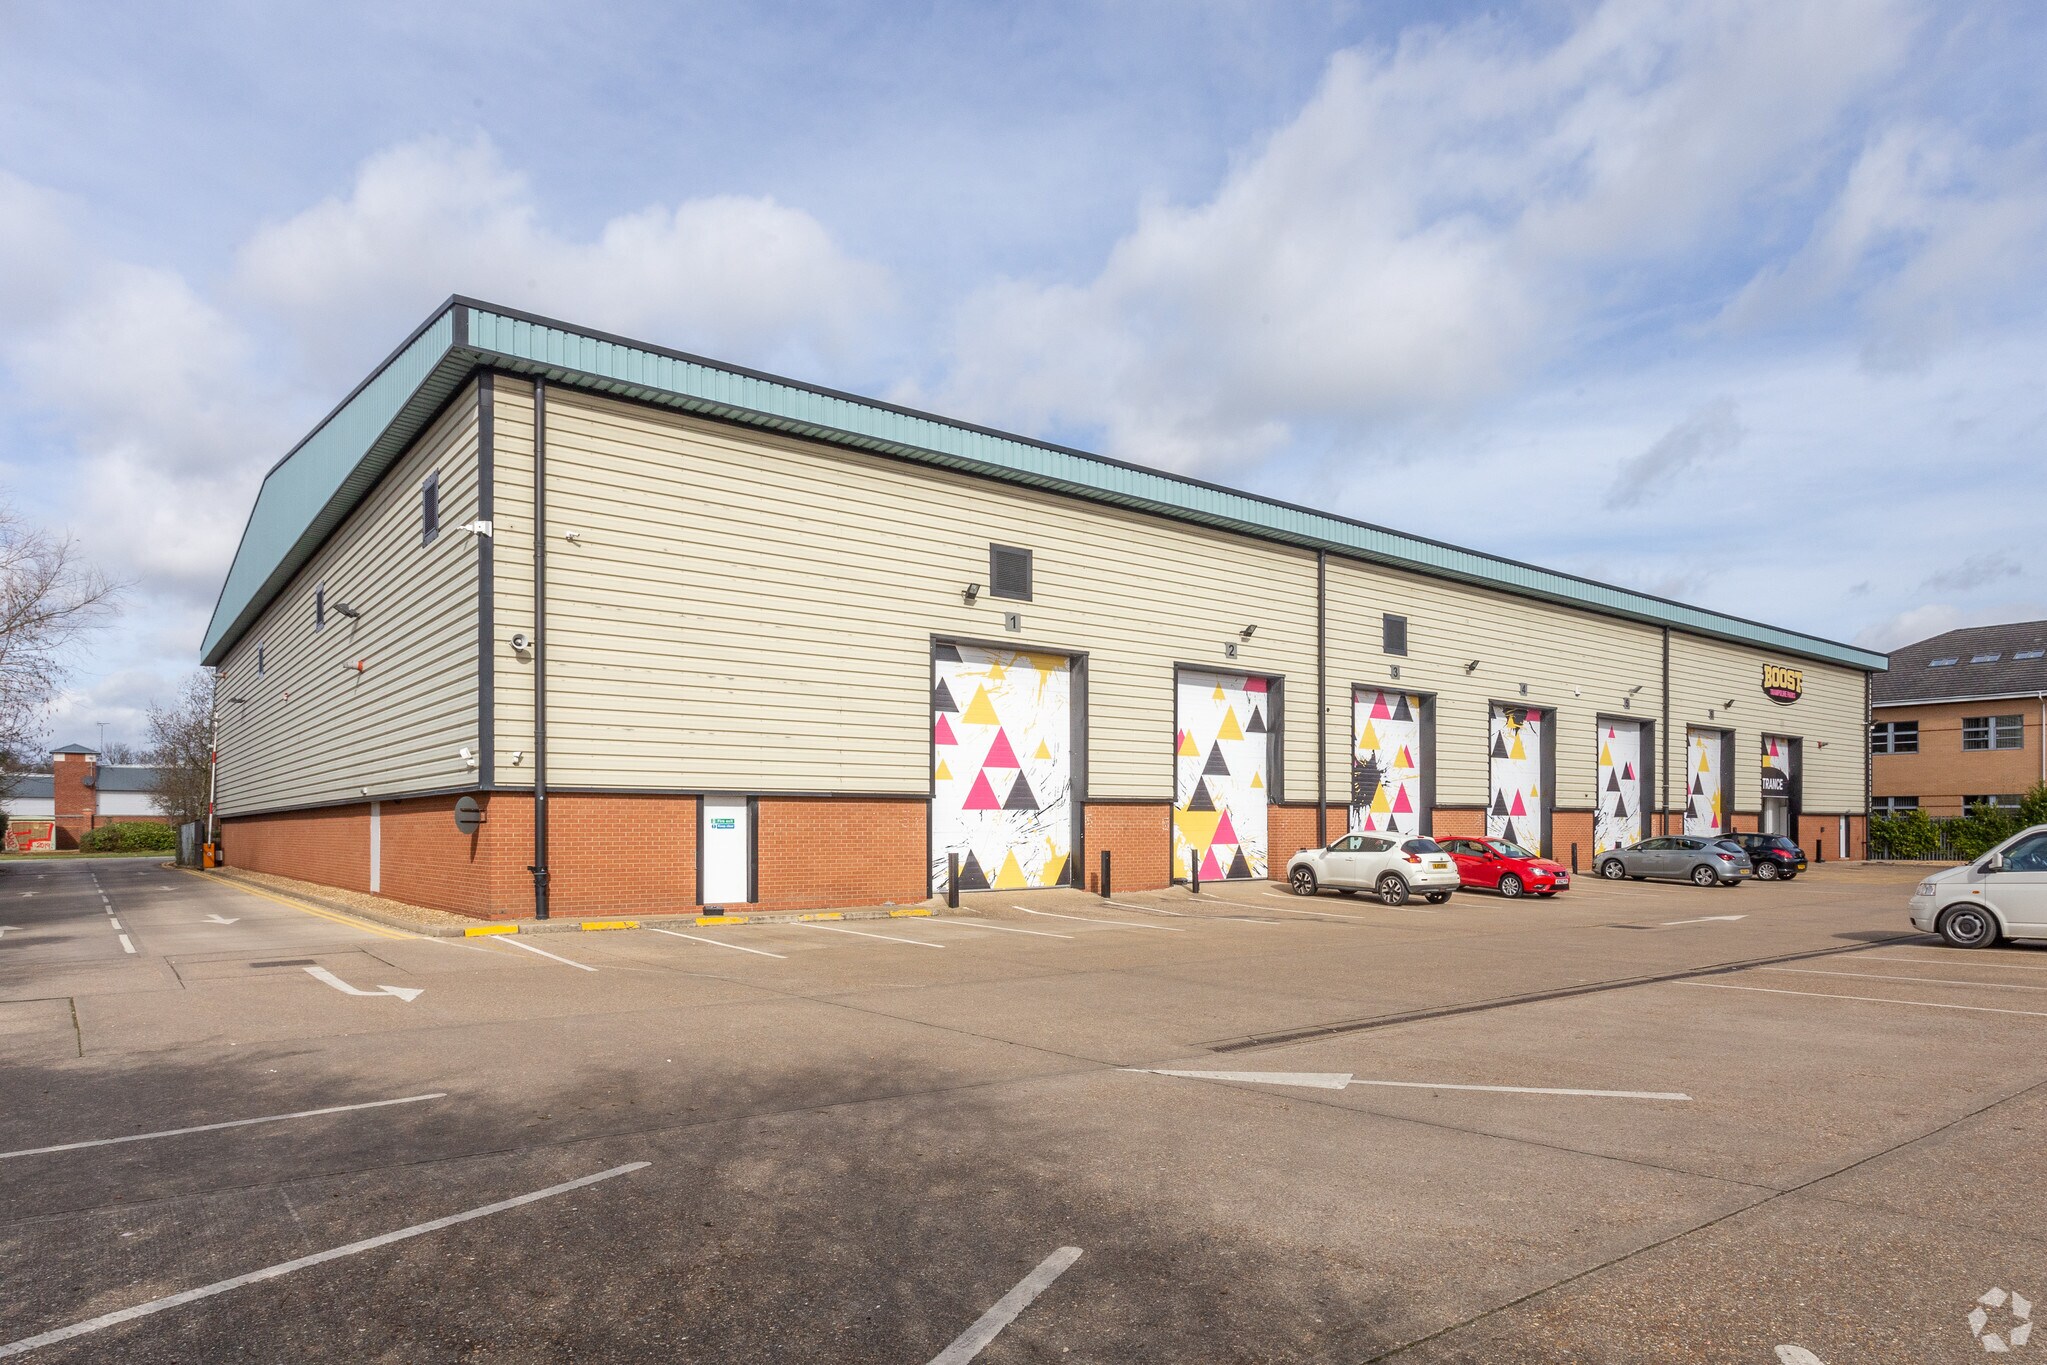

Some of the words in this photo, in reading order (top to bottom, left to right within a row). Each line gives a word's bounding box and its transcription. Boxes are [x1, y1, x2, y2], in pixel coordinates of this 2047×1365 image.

[1010, 615, 1016, 629] 1
[1228, 644, 1235, 657] 2
[1393, 666, 1398, 678] 3
[1763, 664, 1802, 693] BOOST
